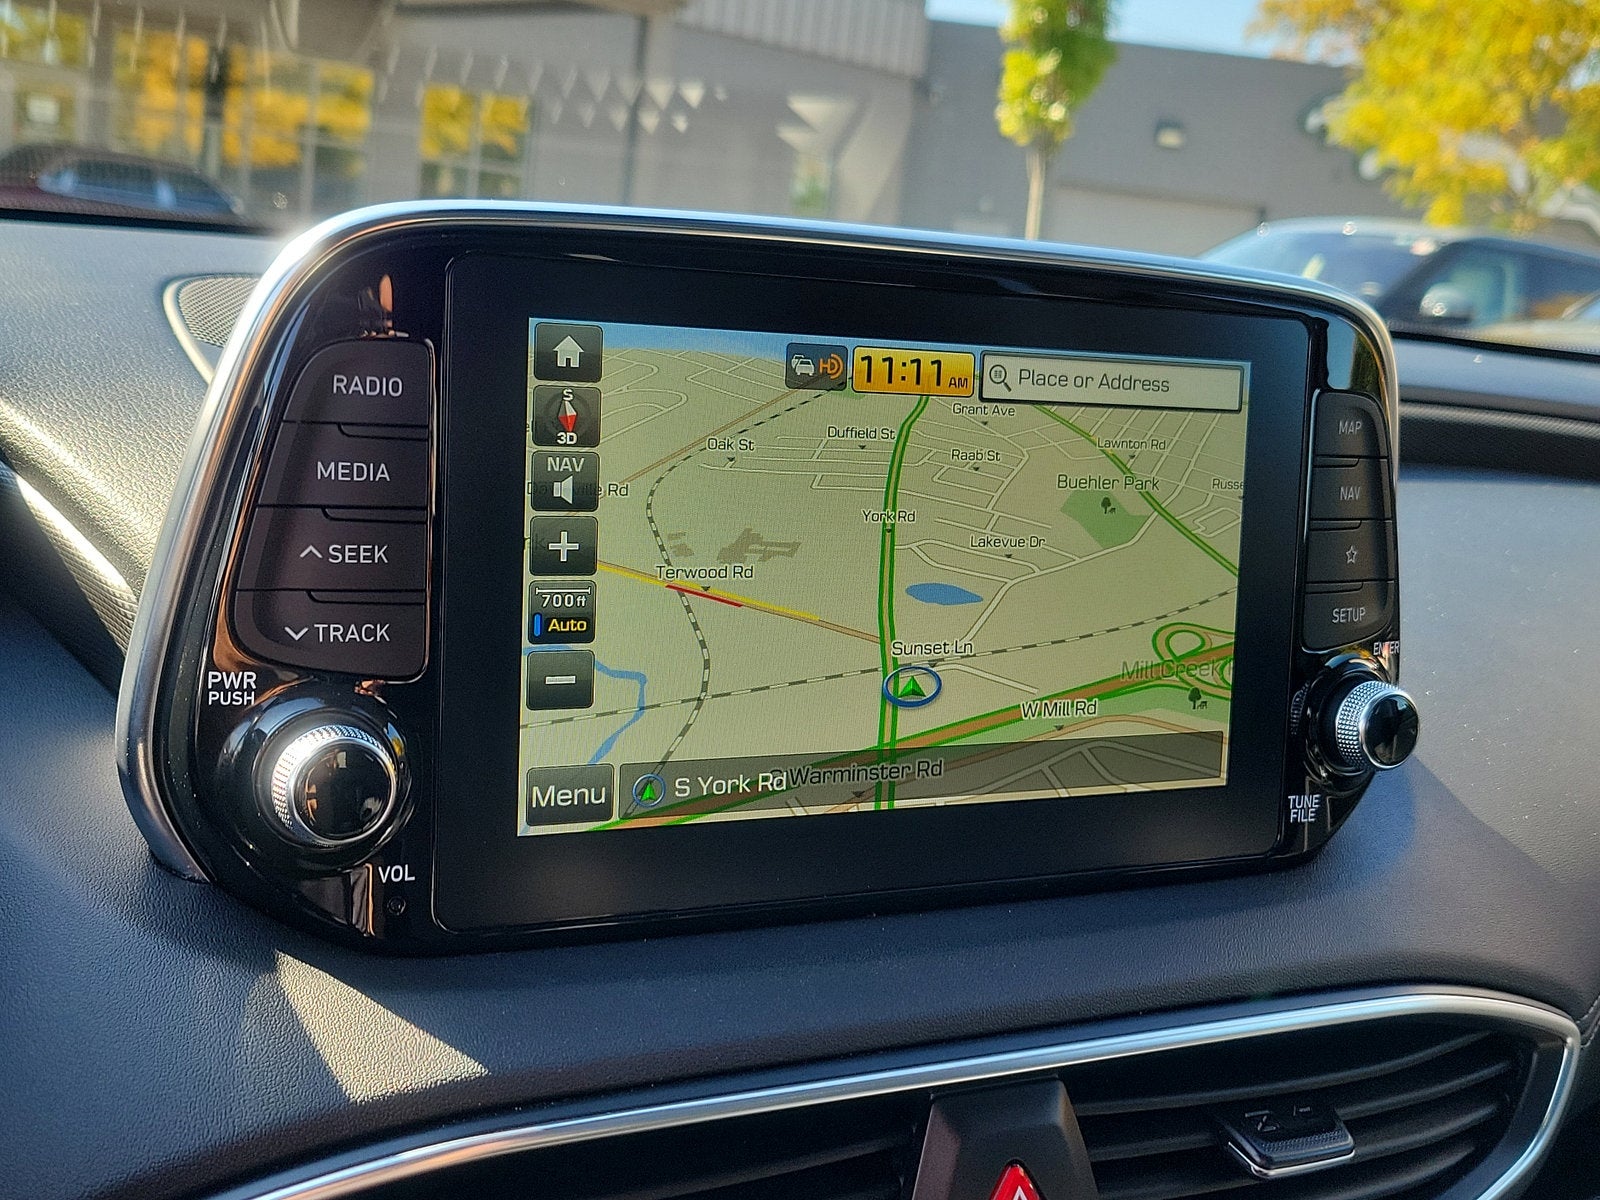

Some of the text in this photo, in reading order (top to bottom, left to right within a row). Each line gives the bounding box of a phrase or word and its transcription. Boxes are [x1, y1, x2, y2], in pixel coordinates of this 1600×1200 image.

[860, 355, 968, 389] 11:11 AM
[332, 375, 403, 397] RADIO
[1018, 369, 1170, 393] Place or Address
[563, 389, 574, 401] S
[952, 403, 1016, 417] Grant Ave
[827, 426, 895, 440] Duffield St
[1338, 420, 1363, 435] MAP
[556, 432, 578, 445] 3D
[707, 437, 755, 451] Oak St
[1097, 437, 1166, 451] Lawnton Rd
[951, 449, 1001, 462] Raab St
[317, 461, 390, 482] MEDIA
[547, 457, 585, 472] NAV
[608, 483, 629, 497] Rd
[1057, 474, 1160, 491] Buehler Park
[1340, 486, 1360, 500] NAV
[862, 509, 916, 523] York Rd
[970, 535, 1046, 548] Lakevue Dr
[328, 545, 388, 564] SEEK
[656, 565, 754, 579] Terwood Rd
[1332, 607, 1366, 624] SETUP
[548, 618, 587, 633] Auto
[313, 624, 391, 643] TRACK
[892, 640, 973, 656] Sunset Ln
[1121, 660, 1154, 680] Mill
[1161, 658, 1220, 678] Creek
[207, 671, 257, 689] PWR
[207, 691, 255, 706] PUSH
[1021, 699, 1097, 718] W Mill Rd
[788, 762, 911, 786] Warminster
[917, 760, 943, 778] Rd
[675, 778, 691, 797] S
[697, 773, 751, 796] York
[758, 772, 787, 792] Rd
[532, 785, 606, 808] Menu
[1288, 794, 1320, 809] TUNE
[1290, 809, 1316, 824] FILE
[378, 864, 416, 883] VOL
